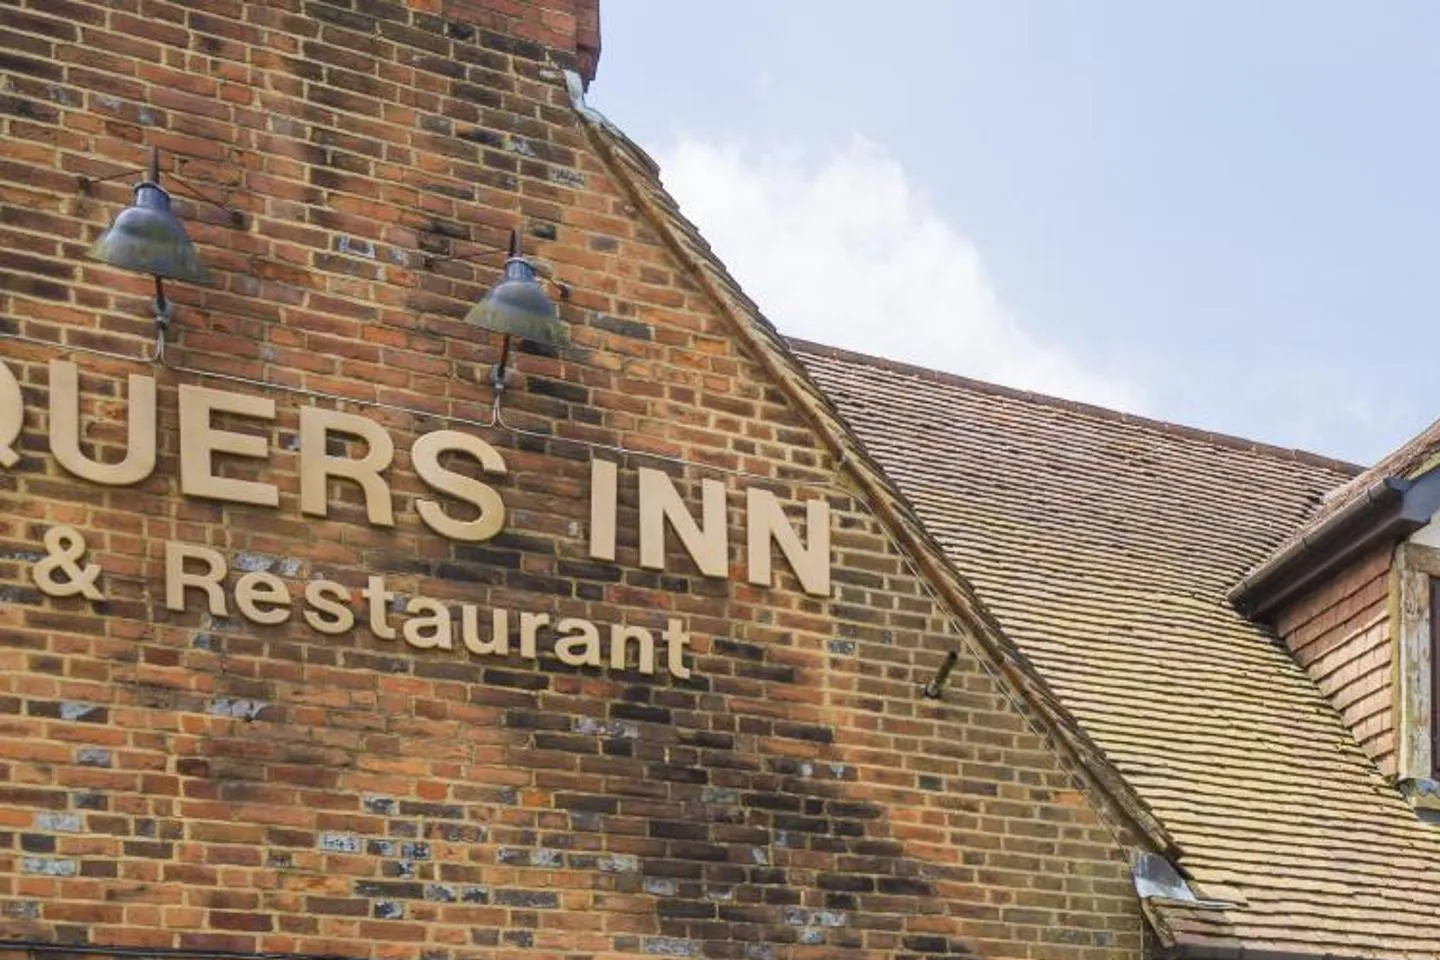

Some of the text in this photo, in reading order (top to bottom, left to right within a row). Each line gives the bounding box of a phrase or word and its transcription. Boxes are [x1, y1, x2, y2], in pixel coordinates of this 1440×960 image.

[590, 458, 830, 597] INN
[33, 525, 690, 679] & Restaurant
